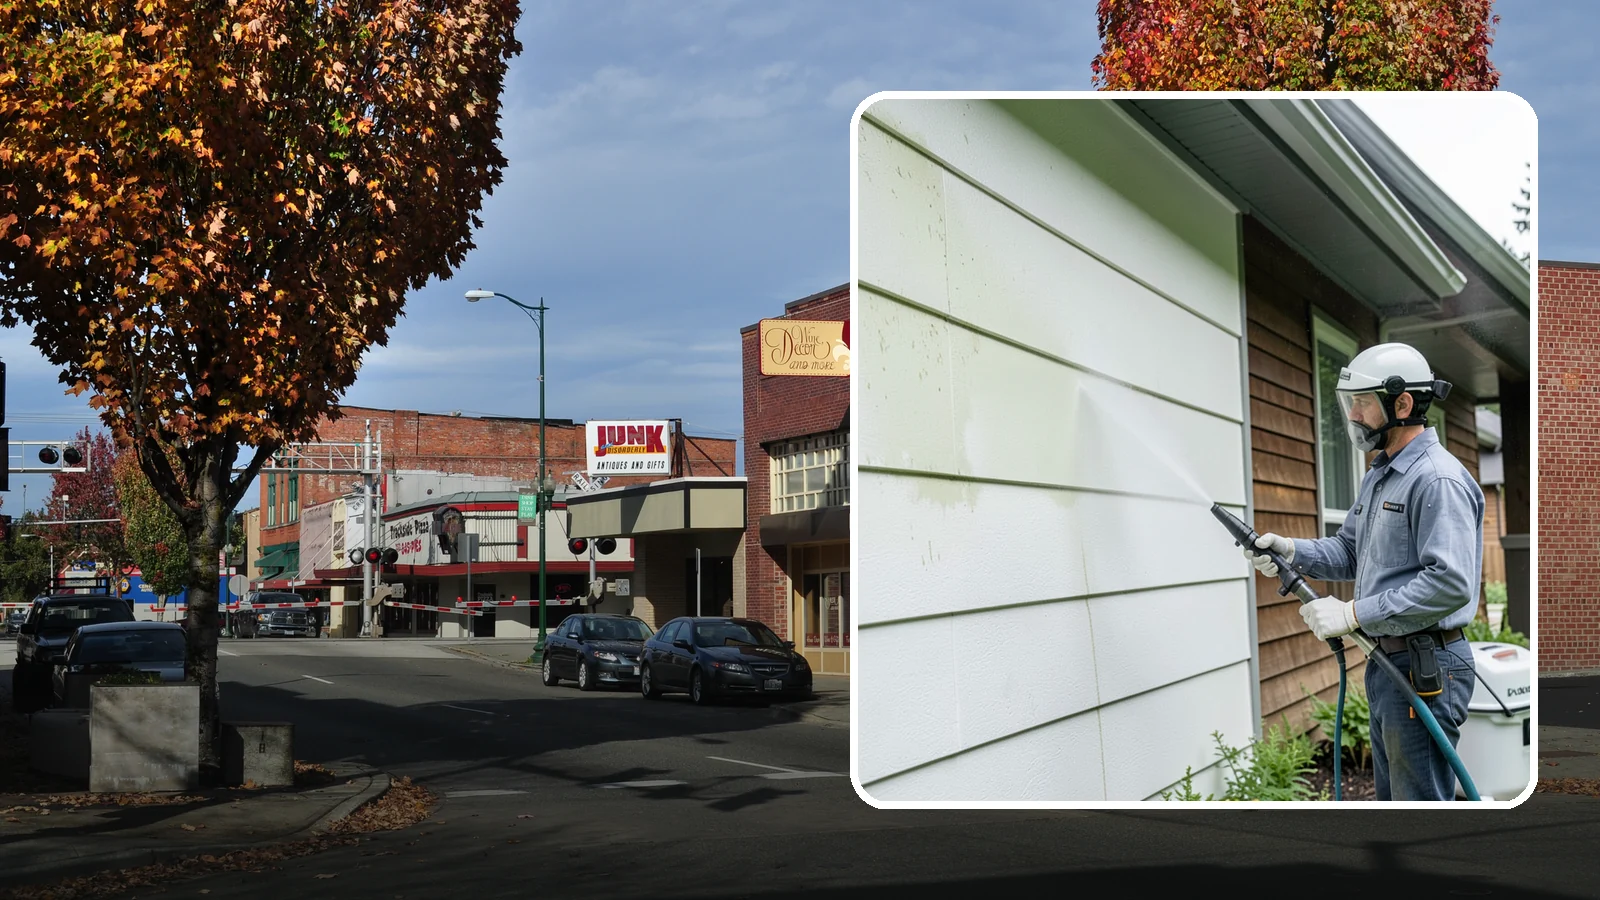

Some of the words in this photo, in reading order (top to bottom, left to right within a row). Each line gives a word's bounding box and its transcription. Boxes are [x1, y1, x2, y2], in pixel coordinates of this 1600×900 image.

[596, 425, 664, 457] JUNK
[607, 446, 646, 454] DISORDERLY
[597, 461, 628, 470] ANTIQUES
[631, 461, 644, 470] AND
[647, 461, 665, 469] GIFTS
[390, 521, 412, 540] Trackside
[414, 519, 429, 535] Pizza
